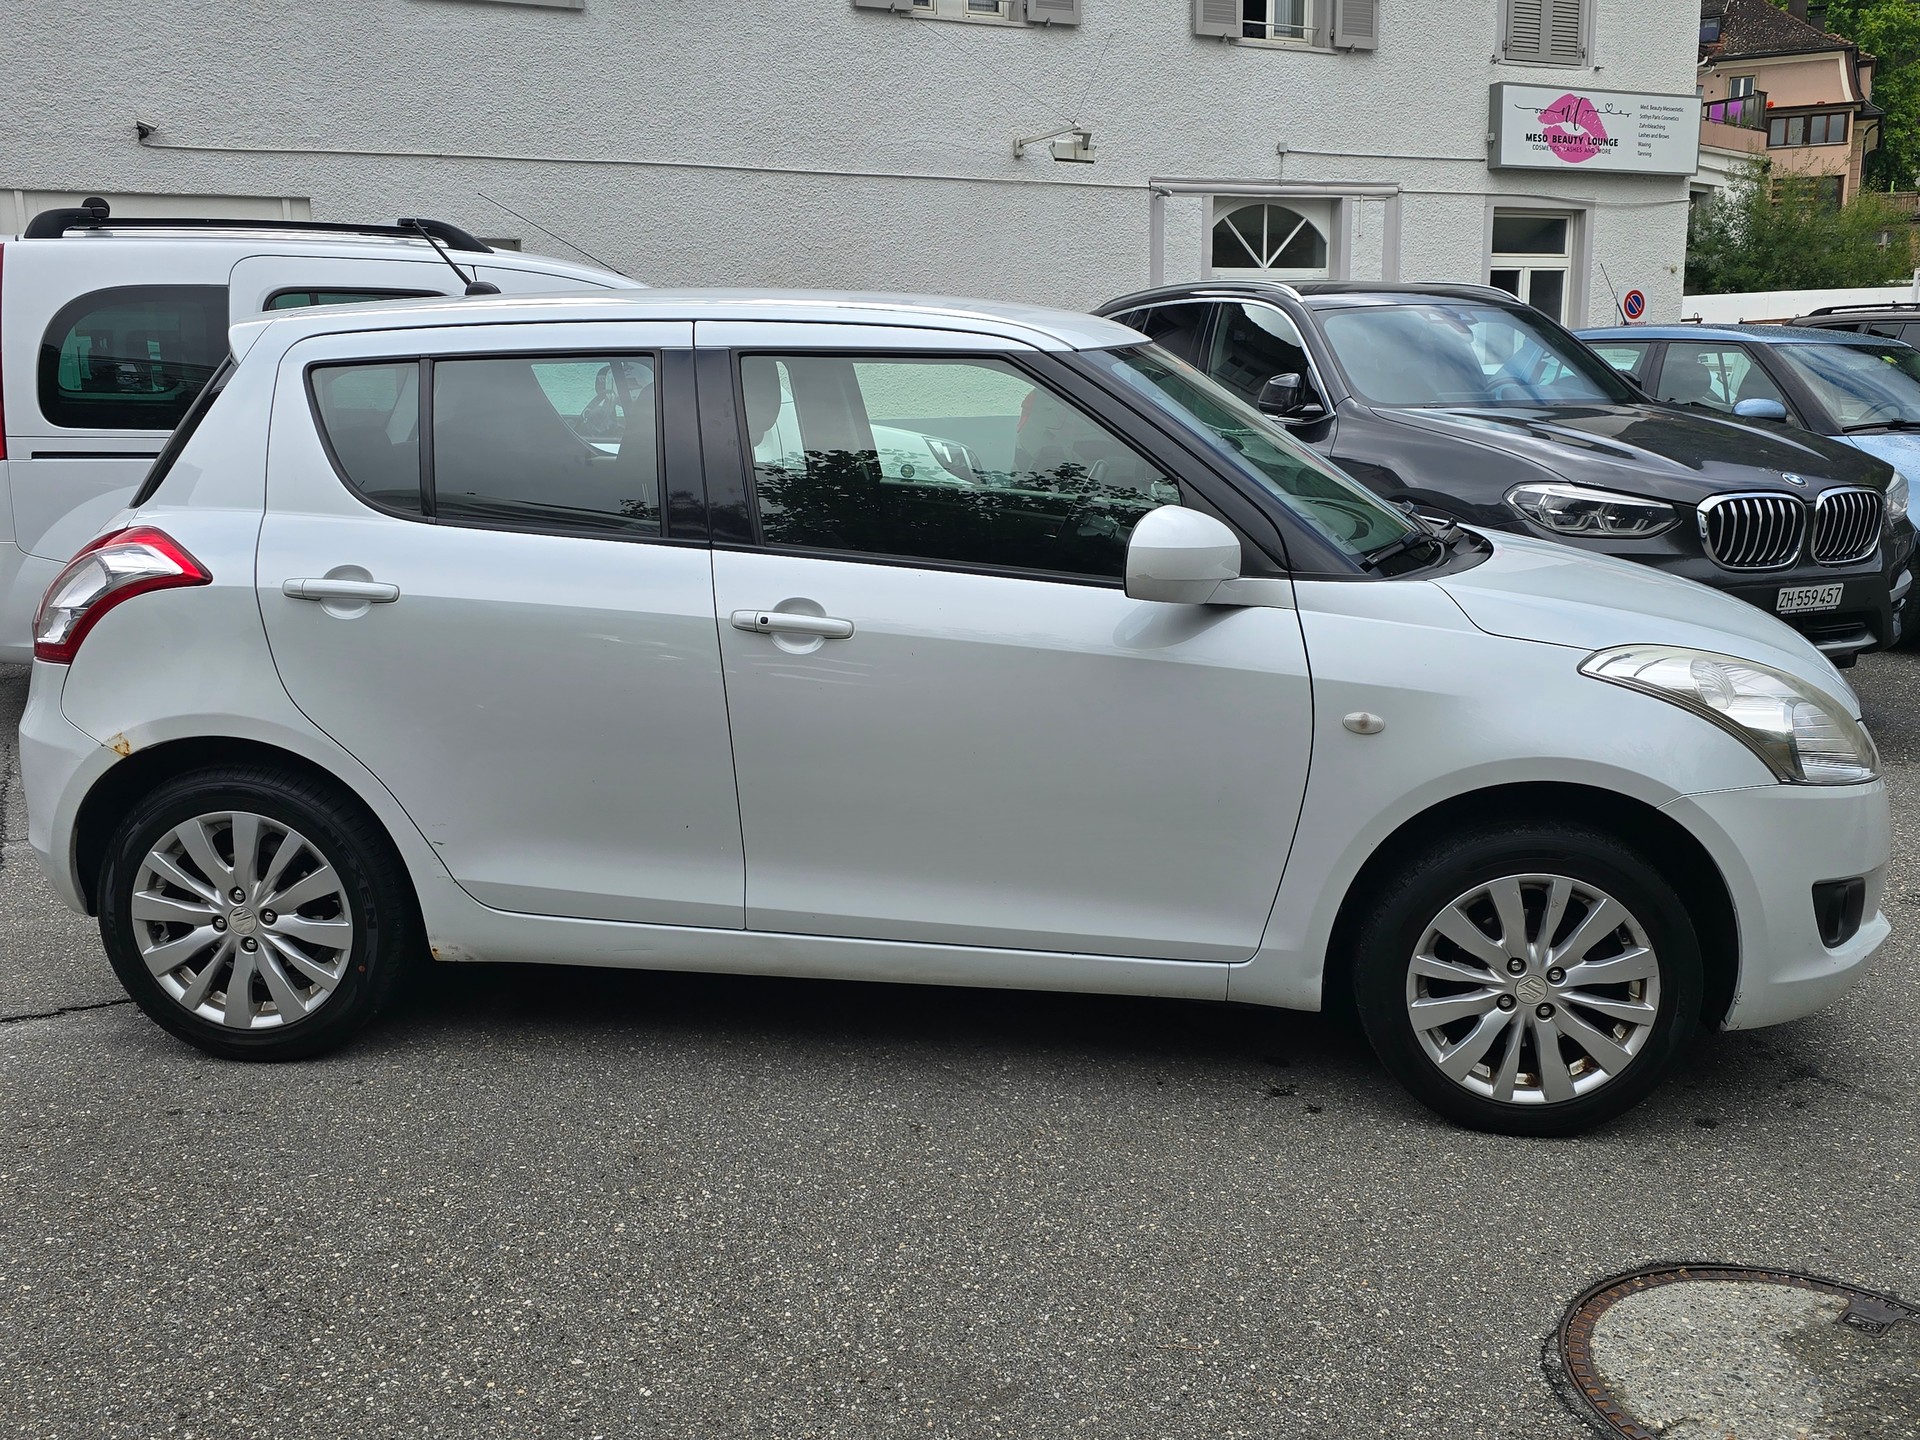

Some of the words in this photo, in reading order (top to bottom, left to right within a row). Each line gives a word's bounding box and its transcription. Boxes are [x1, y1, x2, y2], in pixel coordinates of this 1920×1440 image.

[1525, 133, 1548, 142] MESO
[1552, 134, 1585, 145] BEAUTY
[1587, 137, 1619, 147] LOUNGE
[319, 824, 378, 930] NEXEN
